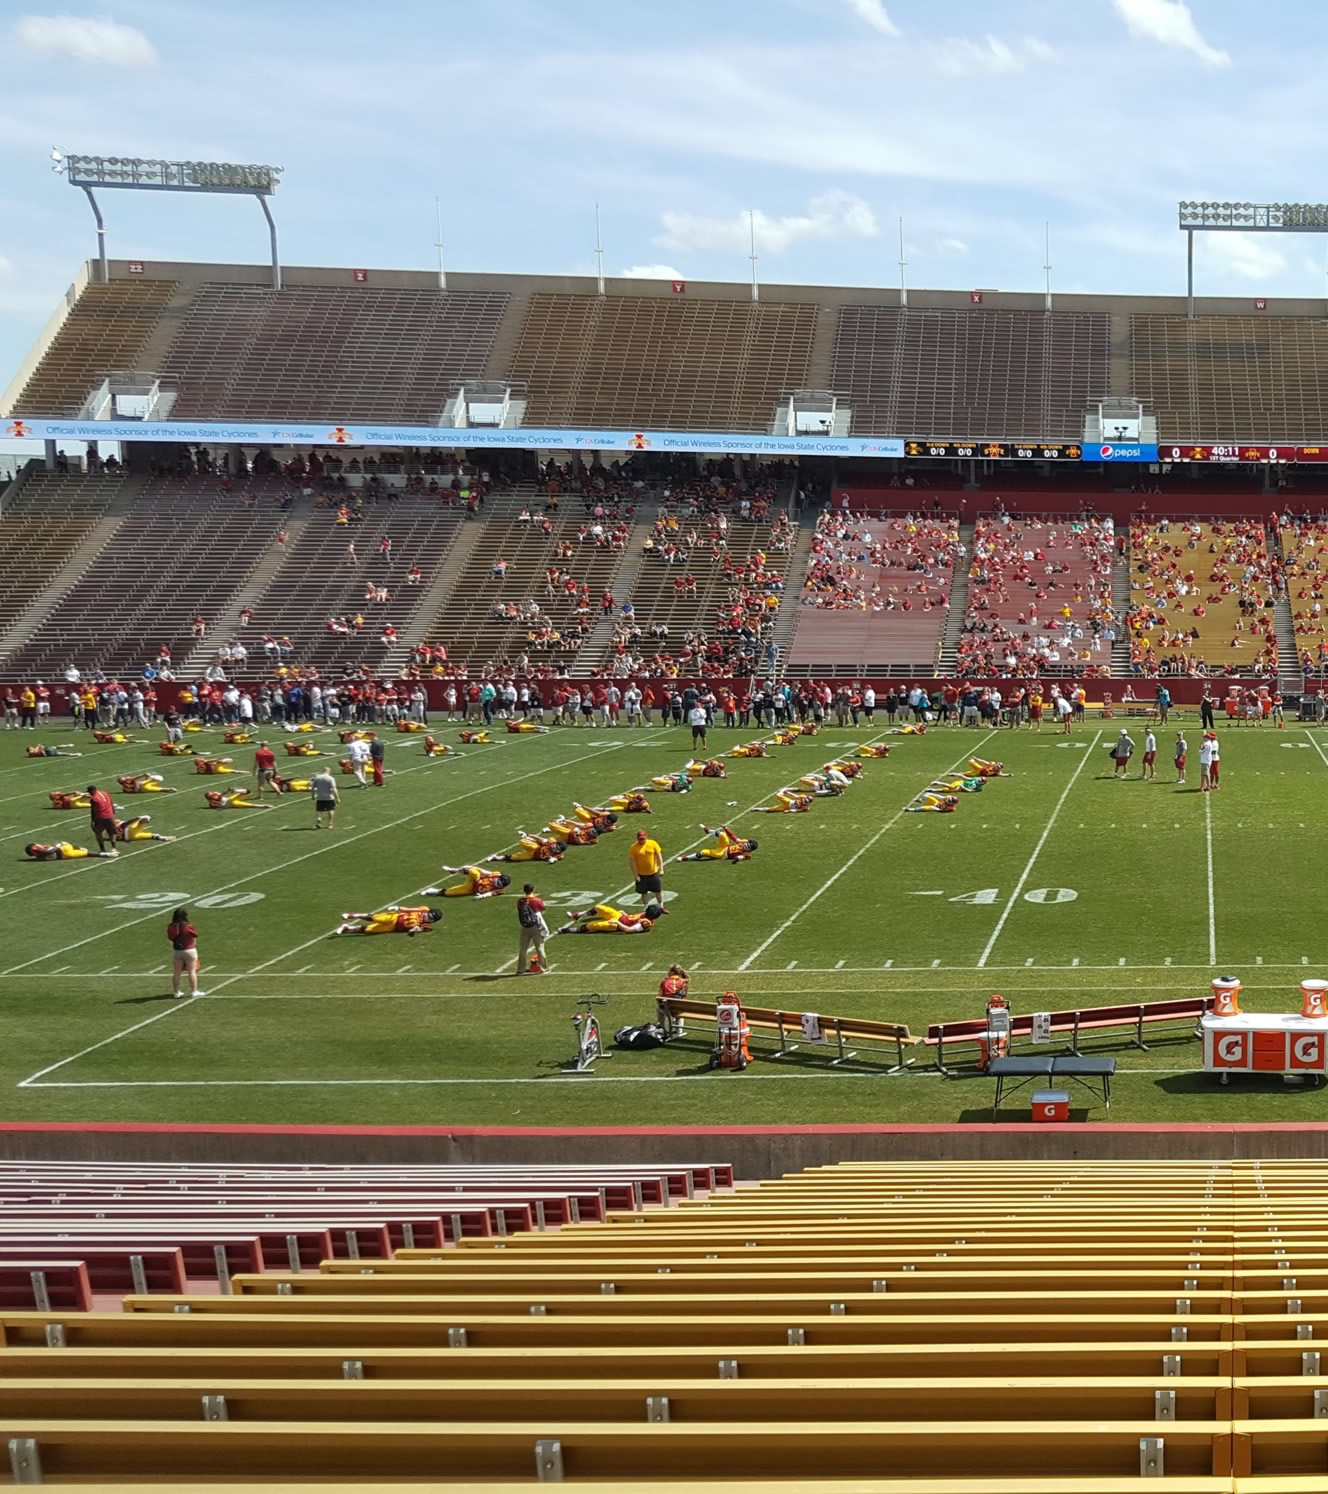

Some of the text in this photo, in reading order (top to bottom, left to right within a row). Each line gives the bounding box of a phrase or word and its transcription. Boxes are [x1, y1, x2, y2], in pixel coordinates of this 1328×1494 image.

[973, 295, 980, 303] X
[46, 425, 259, 441] Official Wireless Sponsor of the Iowa State Cyclones
[366, 432, 393, 441] Official
[395, 433, 427, 441] Wireless
[428, 434, 460, 443] Sponsor
[506, 436, 526, 444] State
[528, 436, 563, 445] Cyclones
[690, 440, 720, 448] Wireless
[723, 440, 752, 450] Sponsor
[778, 442, 794, 450] Iowa
[816, 444, 849, 452] Cyclones
[930, 447, 946, 456] 0/0
[958, 448, 972, 456] 0/0
[1211, 446, 1239, 456] 40:11
[1018, 449, 1032, 458] 0/0
[1044, 450, 1058, 458] 0/0
[1114, 448, 1140, 458] pepsi
[1172, 448, 1180, 458] 0
[1269, 449, 1277, 458] 0
[104, 892, 266, 909] 20
[542, 890, 678, 907] 30
[948, 888, 1078, 904] 40
[1219, 992, 1231, 1005] G
[1310, 992, 1321, 1006] G
[1218, 1035, 1242, 1062] G
[1294, 1036, 1318, 1062] G
[1044, 1104, 1056, 1116] G
